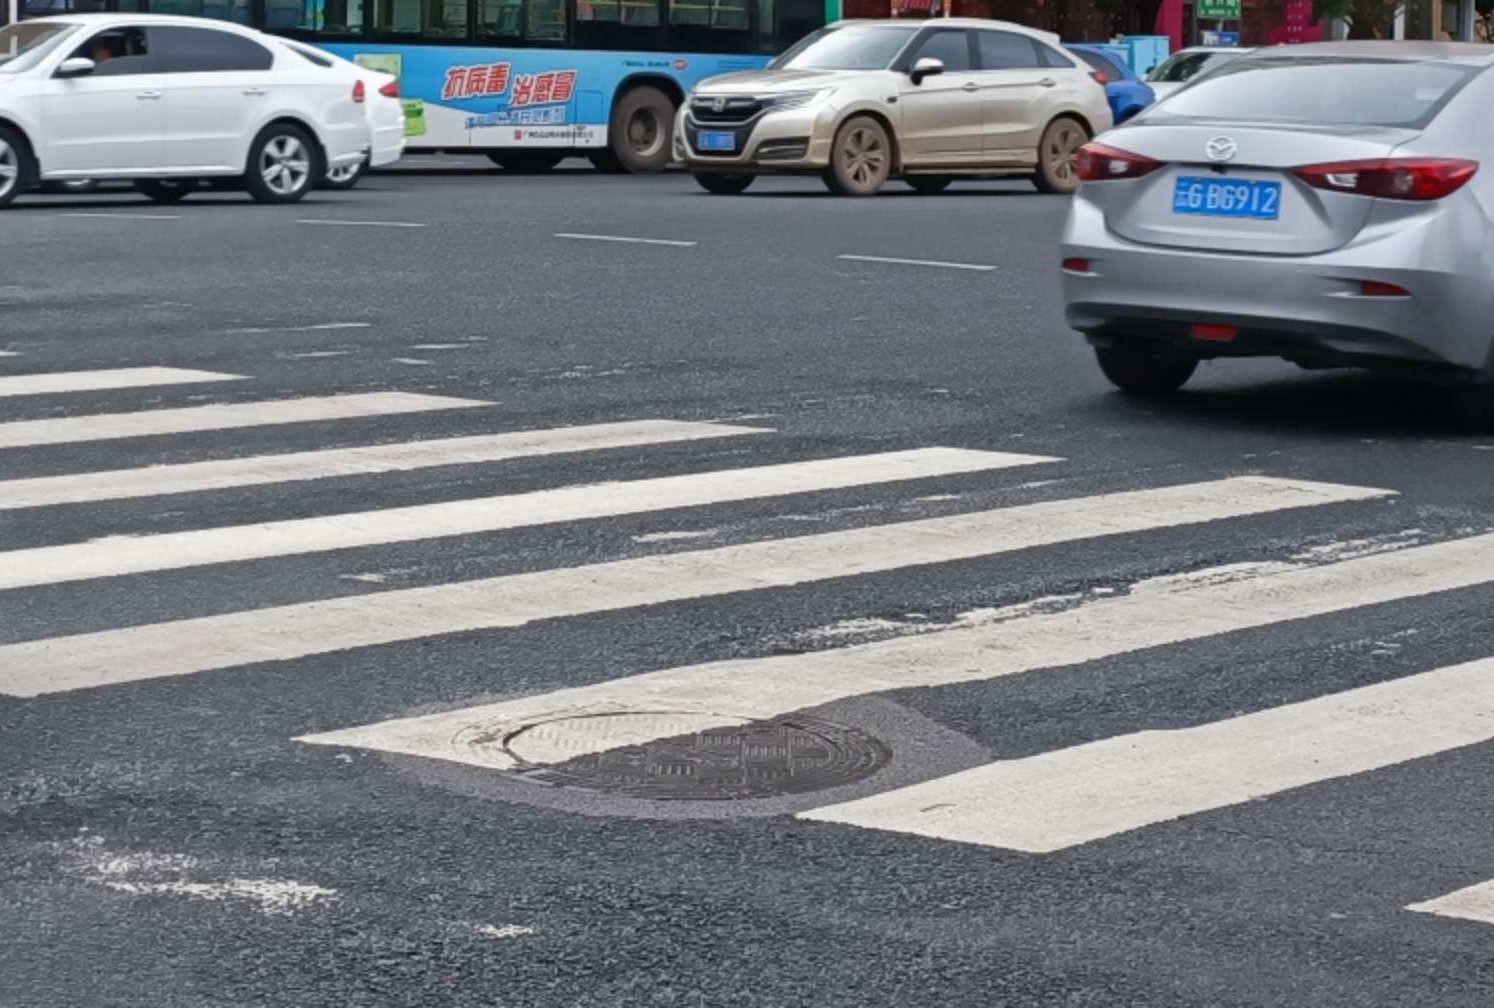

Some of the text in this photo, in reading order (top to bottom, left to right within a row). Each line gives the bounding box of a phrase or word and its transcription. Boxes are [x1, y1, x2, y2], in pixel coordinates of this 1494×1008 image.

[443, 63, 576, 106] 抗病毒 治感冒
[1206, 183, 1278, 213] BG912
